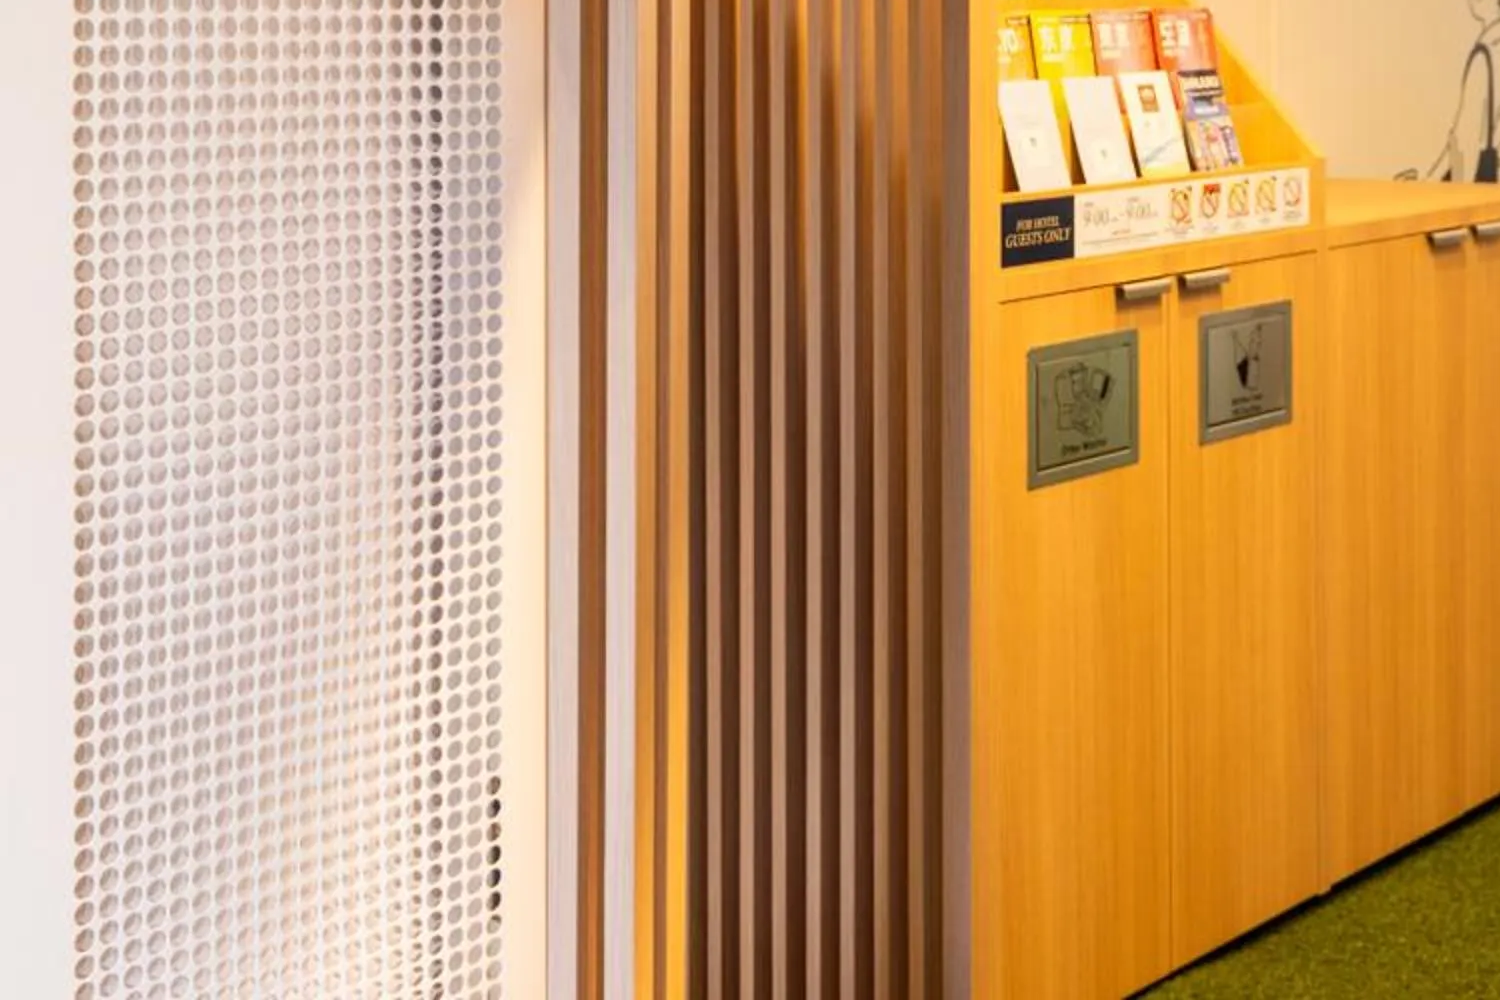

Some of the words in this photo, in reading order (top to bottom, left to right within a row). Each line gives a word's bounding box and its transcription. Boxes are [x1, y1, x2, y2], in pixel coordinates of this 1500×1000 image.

[1034, 215, 1060, 229] HOTEL
[1005, 231, 1044, 249] GUESTS
[1044, 226, 1072, 245] ONLY
